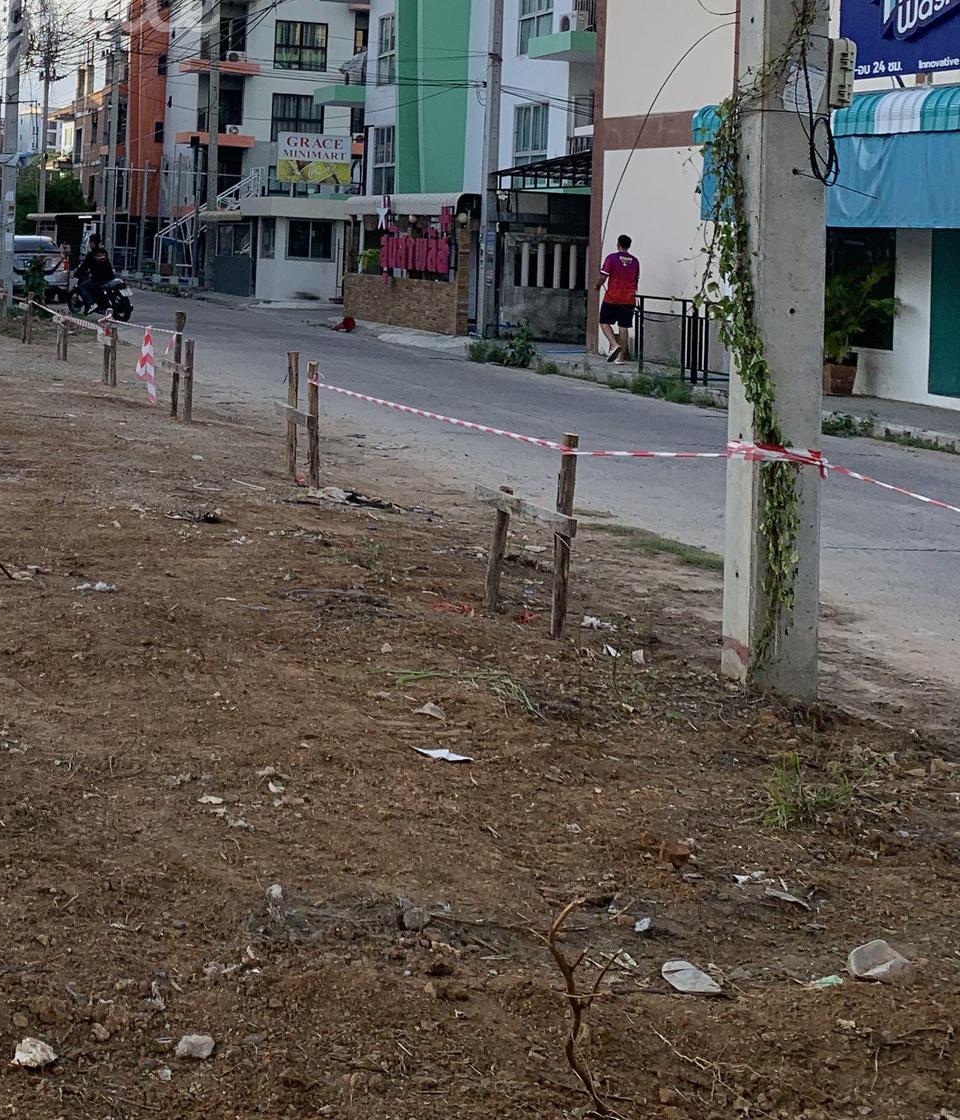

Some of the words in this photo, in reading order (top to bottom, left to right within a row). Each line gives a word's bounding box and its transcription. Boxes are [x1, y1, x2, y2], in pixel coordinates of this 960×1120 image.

[873, 61, 886, 74] 24
[918, 57, 960, 70] Innovative
[287, 136, 344, 149] GRACE
[283, 149, 346, 160] MINIMART
